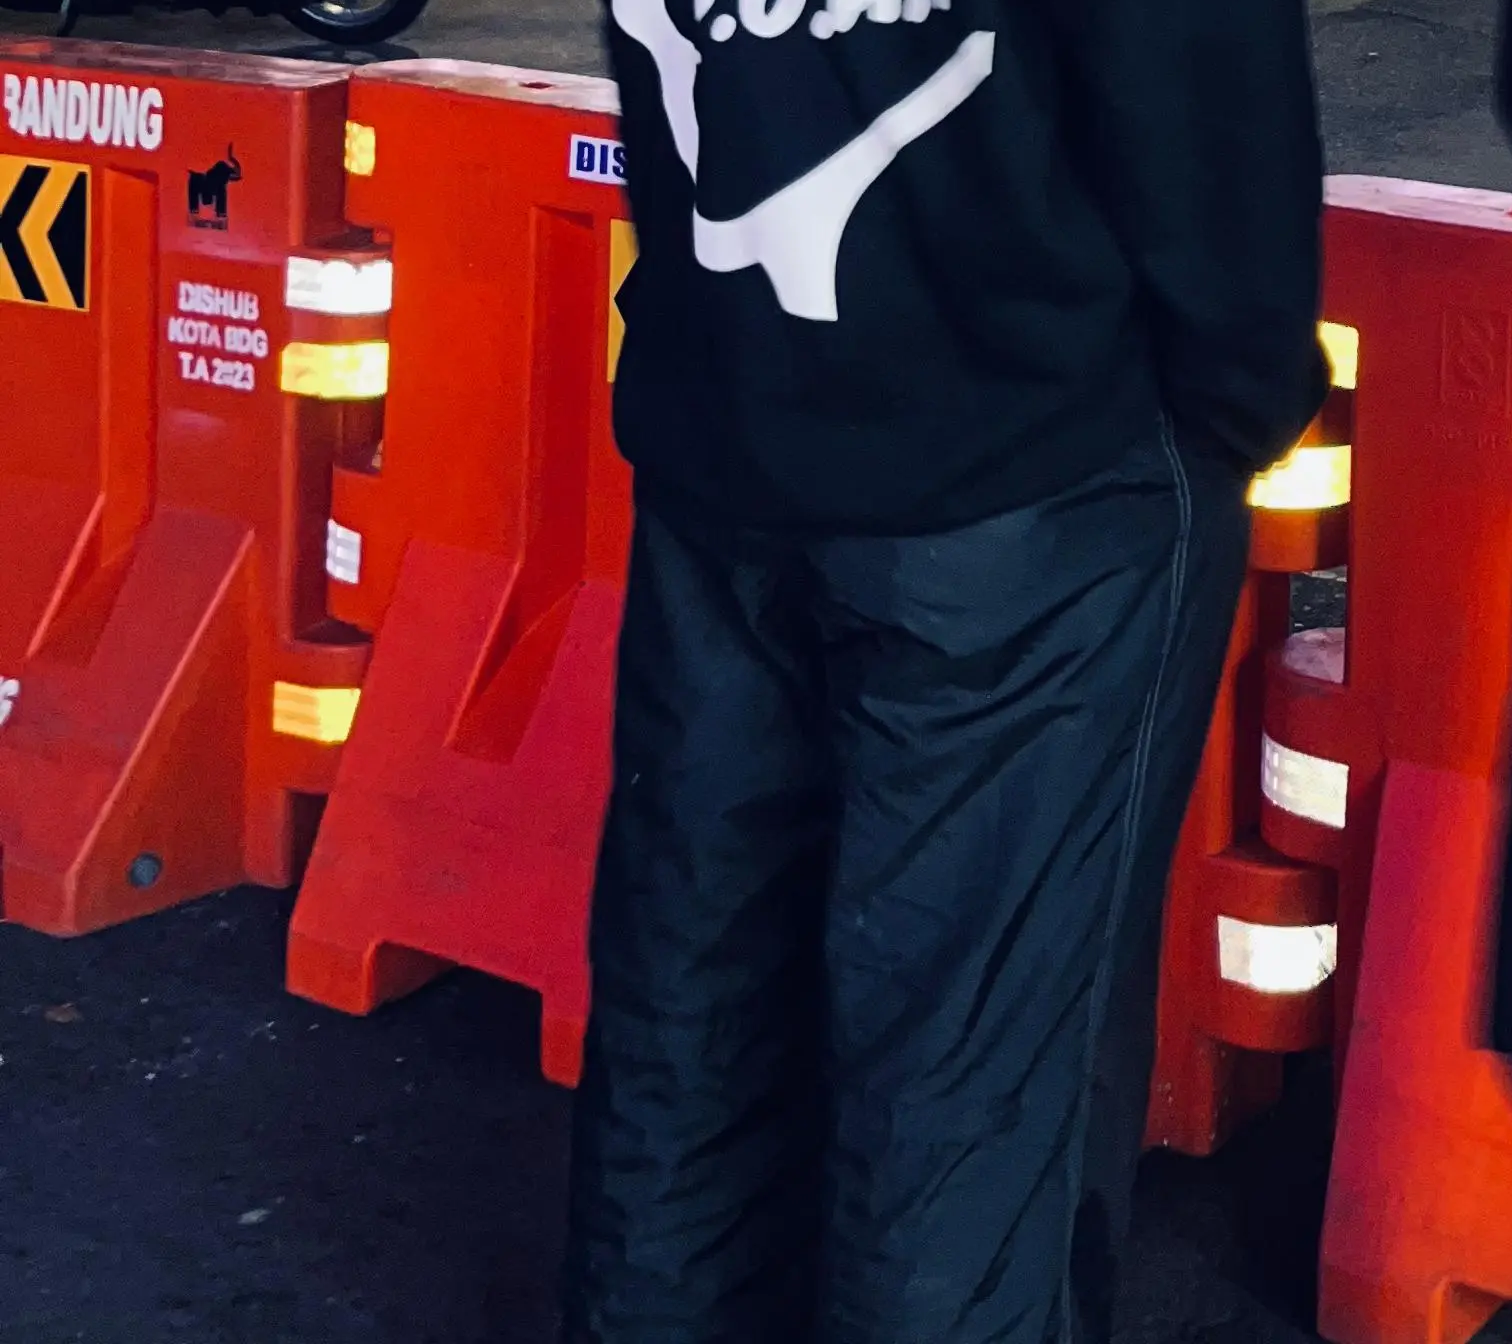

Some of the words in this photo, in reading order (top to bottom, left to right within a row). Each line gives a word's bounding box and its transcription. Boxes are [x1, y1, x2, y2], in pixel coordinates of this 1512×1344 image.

[3, 73, 164, 151] BANDUNG
[178, 280, 260, 321] DISHUB
[168, 316, 222, 349] KOTA
[224, 324, 268, 358] BDG
